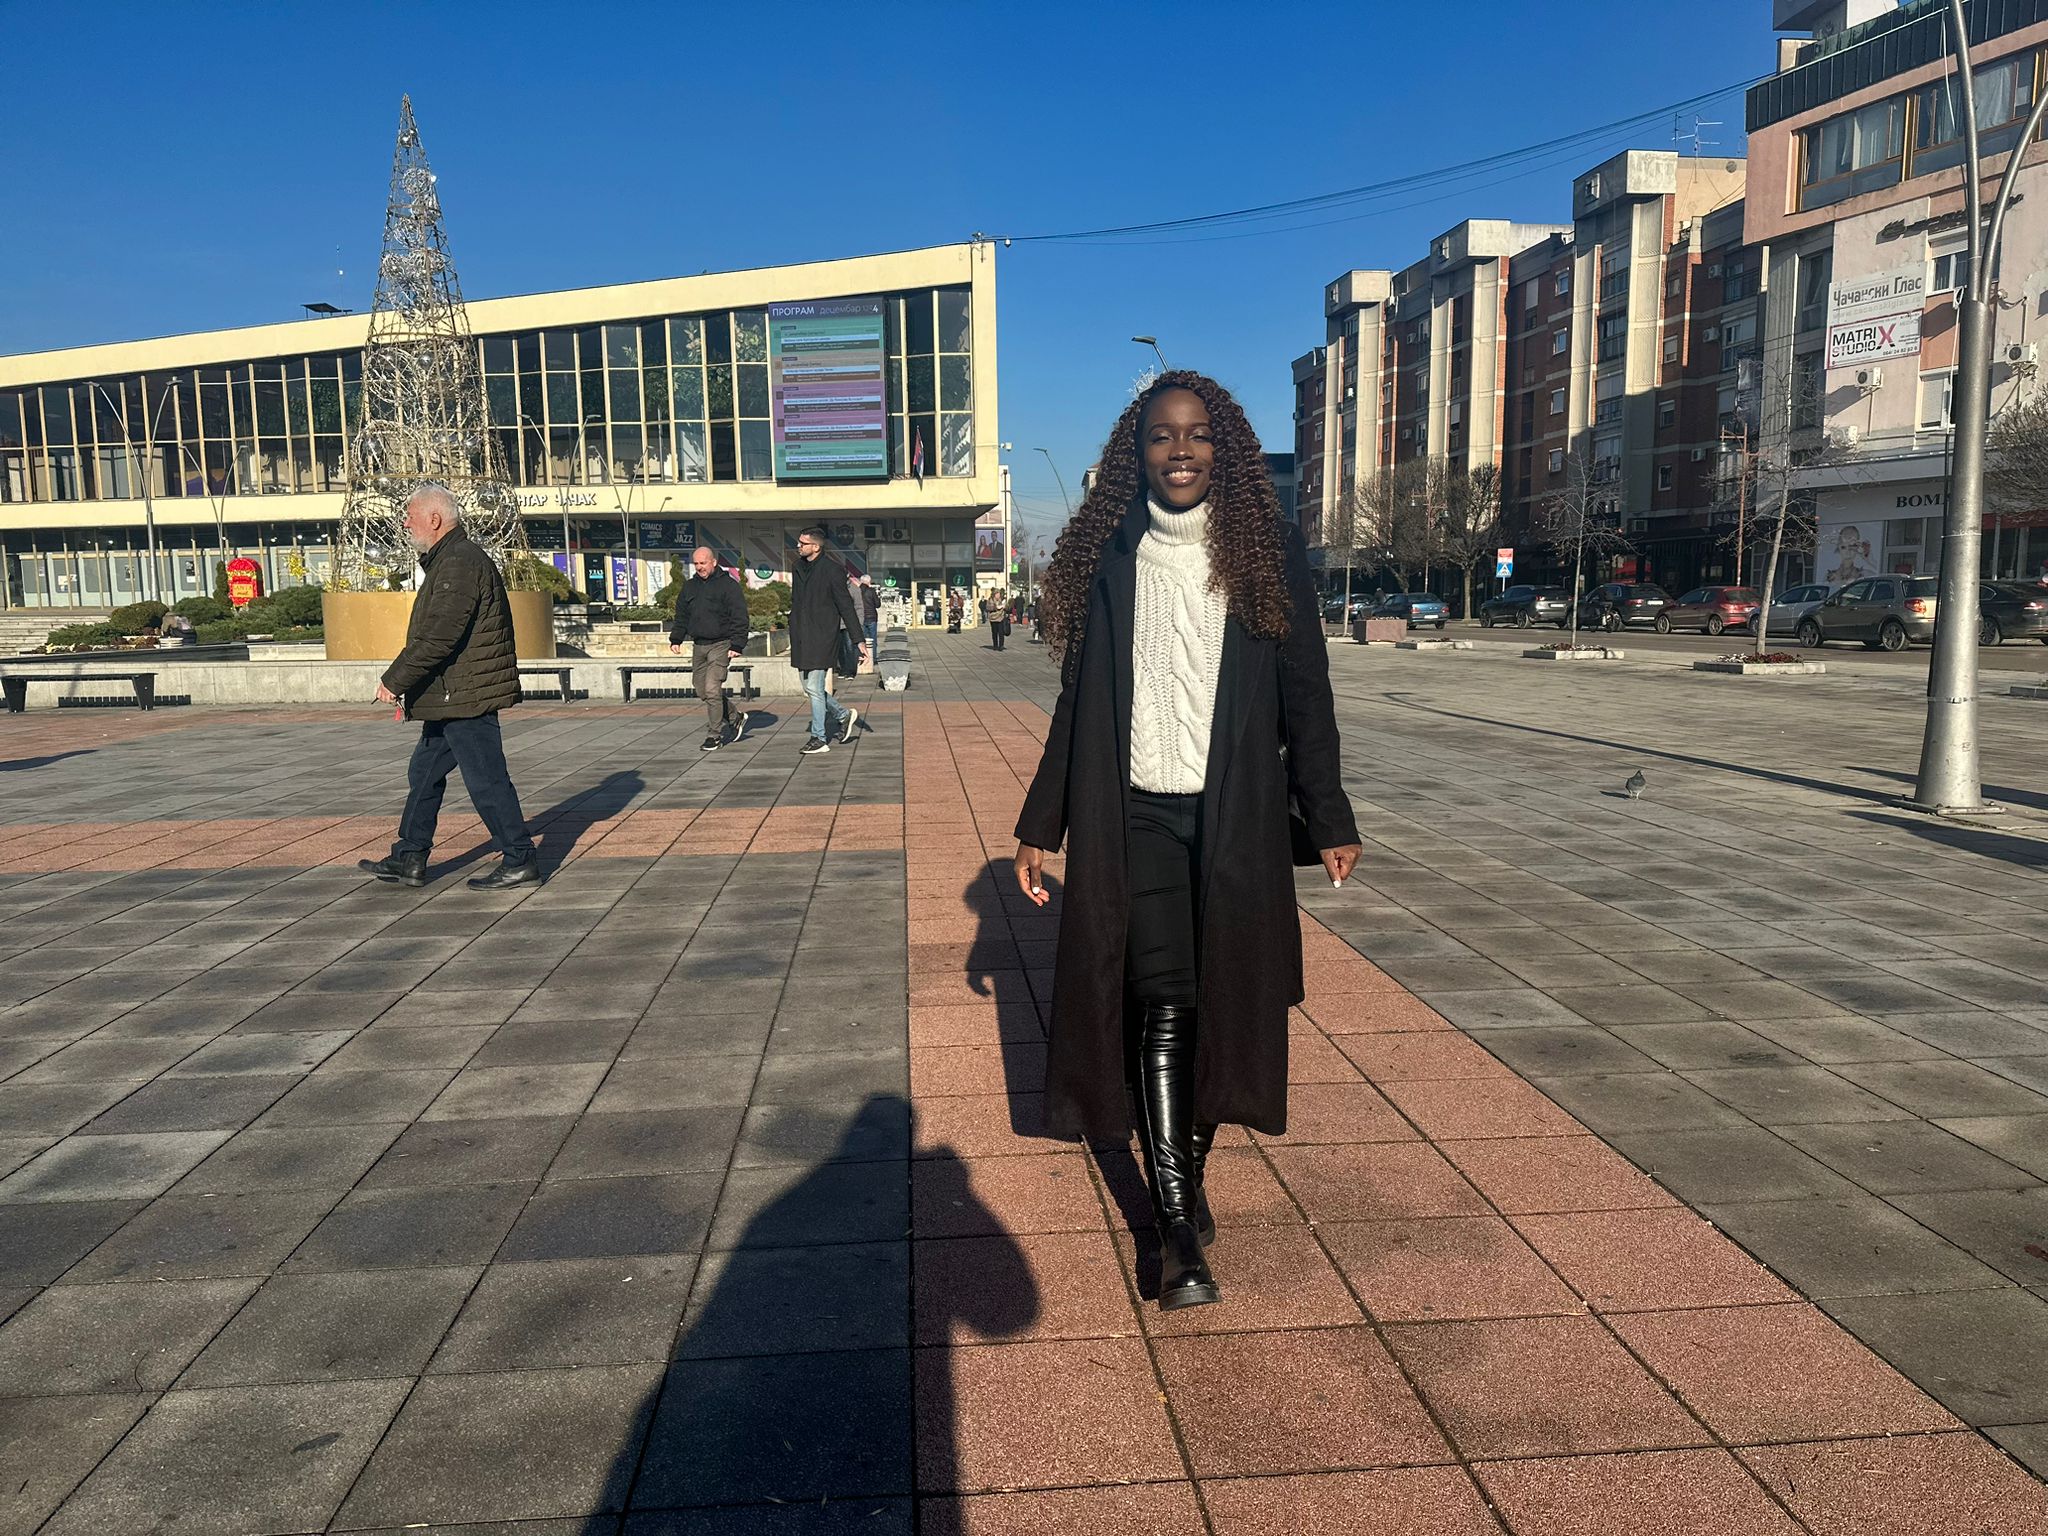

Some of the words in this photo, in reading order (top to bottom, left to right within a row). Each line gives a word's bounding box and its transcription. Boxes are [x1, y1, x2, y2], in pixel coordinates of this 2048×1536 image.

[1833, 284, 1890, 306] Чачански
[1894, 276, 1922, 295] Глас
[772, 306, 815, 316] ПРОГРАМ
[1832, 340, 1877, 358] STUDIO
[555, 492, 597, 507] ЧАЧАК
[641, 522, 663, 531] COMICS
[674, 534, 693, 544] JAZZ
